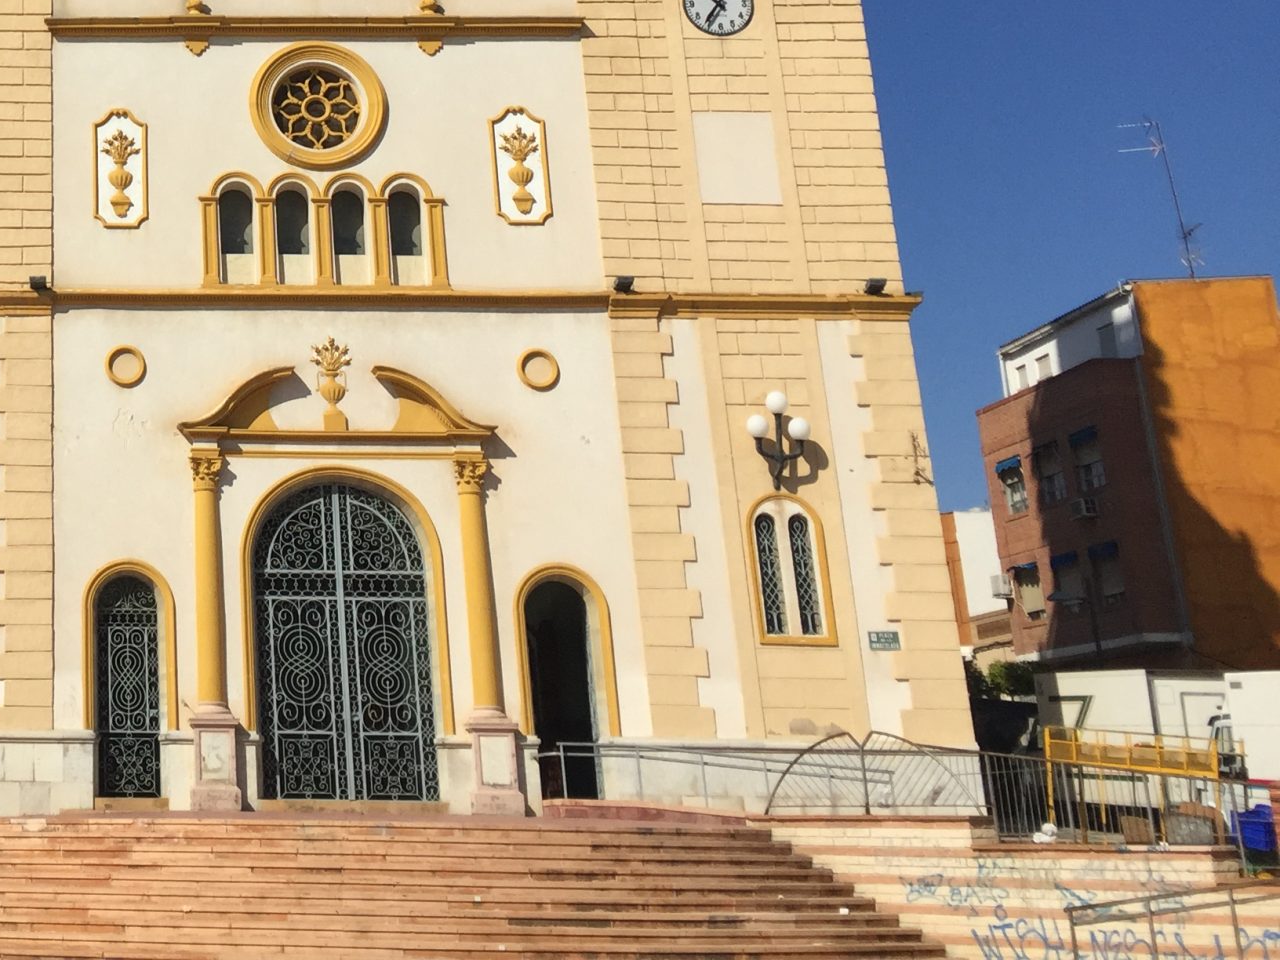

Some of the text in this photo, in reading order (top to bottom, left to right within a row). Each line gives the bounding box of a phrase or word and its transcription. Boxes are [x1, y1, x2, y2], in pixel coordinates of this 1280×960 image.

[689, 0, 695, 8] 9
[738, 11, 744, 19] 4
[718, 22, 724, 31] 6
